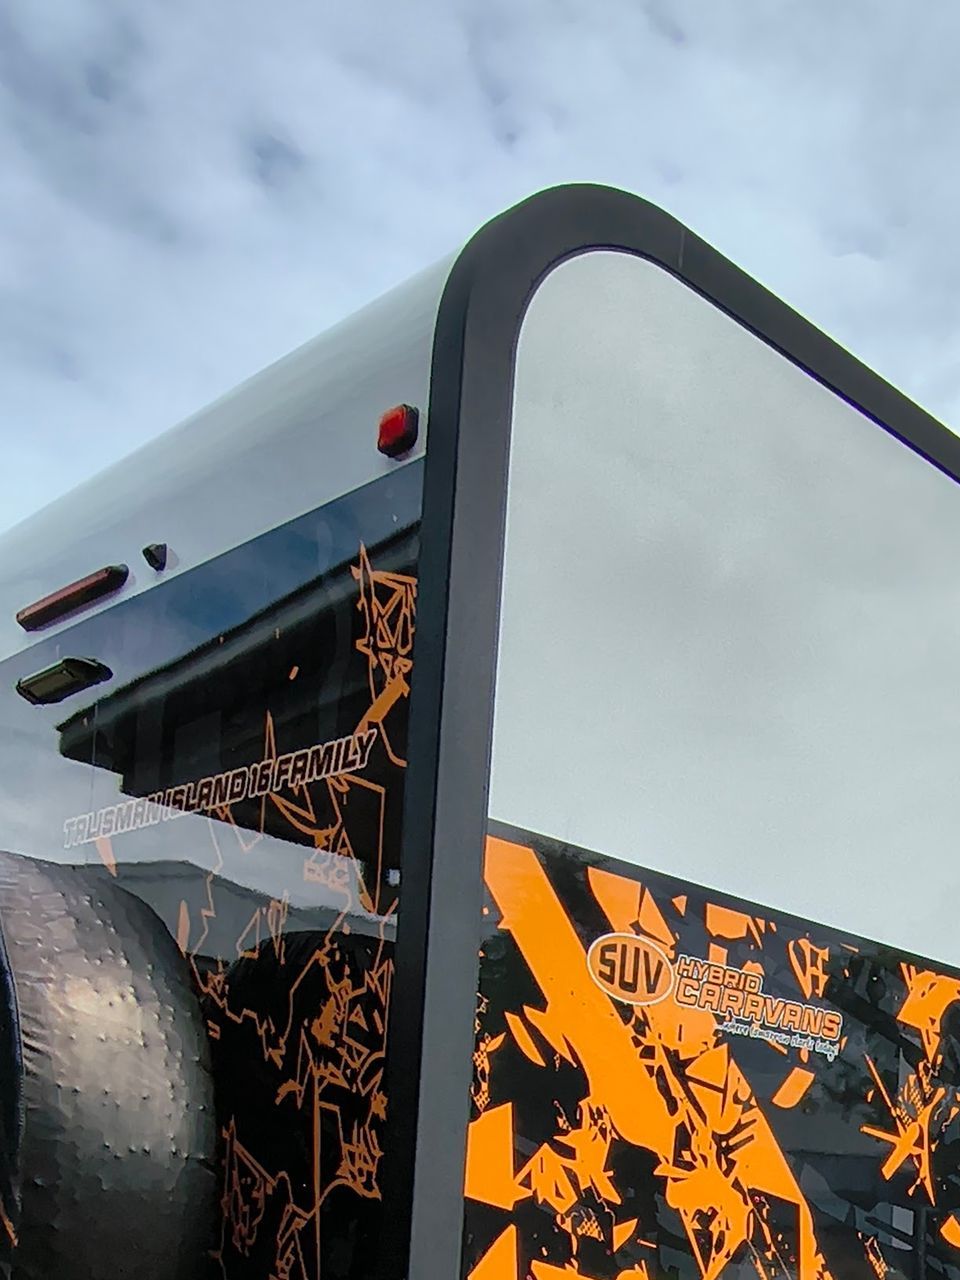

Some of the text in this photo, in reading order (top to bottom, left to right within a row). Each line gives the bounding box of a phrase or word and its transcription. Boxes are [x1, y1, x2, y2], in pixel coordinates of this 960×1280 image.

[63, 729, 378, 848] TALISMAN ISLAND 16 FAMILY
[598, 942, 664, 995] SUV
[676, 954, 764, 996] HYBRID
[674, 978, 844, 1042] CARAVANS
